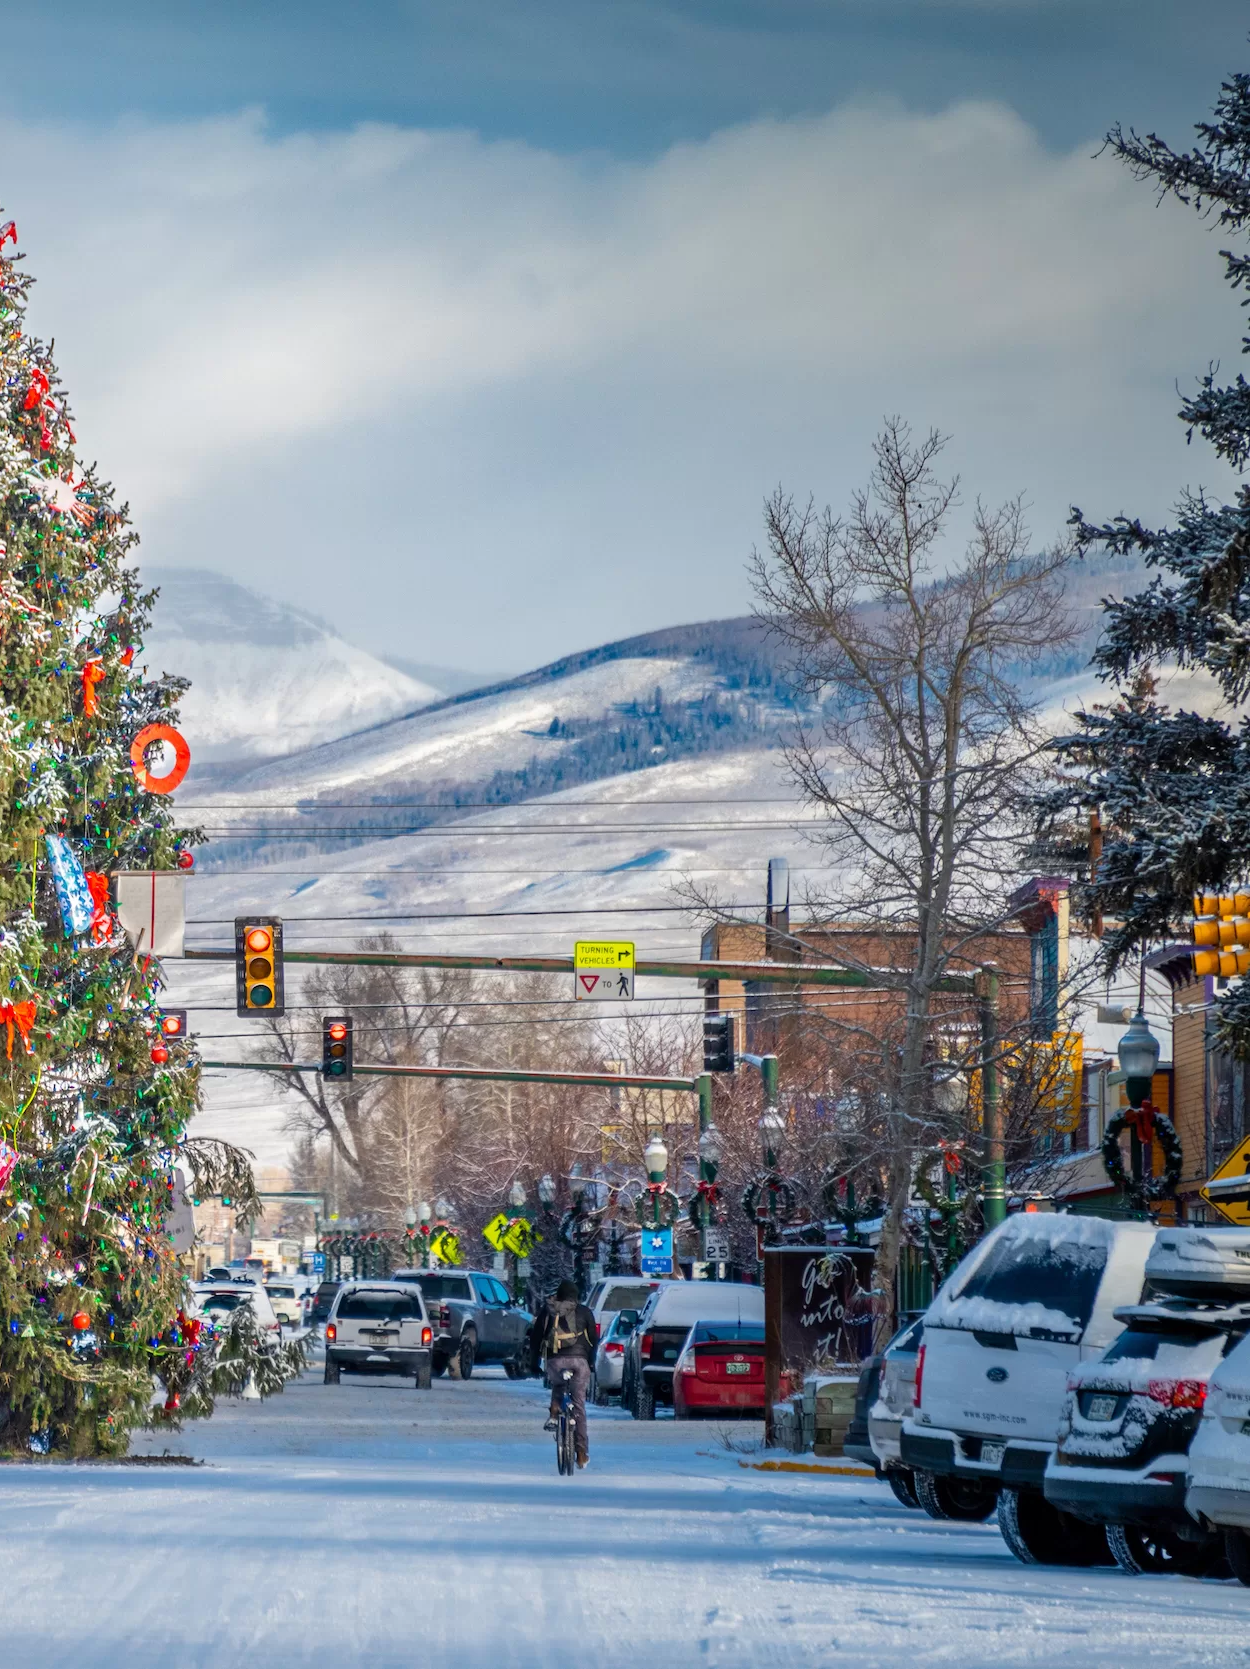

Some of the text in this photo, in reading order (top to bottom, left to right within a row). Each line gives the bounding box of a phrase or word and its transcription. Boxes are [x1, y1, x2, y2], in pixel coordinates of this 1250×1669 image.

[581, 946, 614, 954] TURNING
[579, 957, 615, 965] VEHICLES
[706, 1246, 728, 1258] 25
[315, 1255, 323, 1264] H
[800, 1294, 844, 1327] into
[962, 1409, 1027, 1425] www.sgm-inc.com
